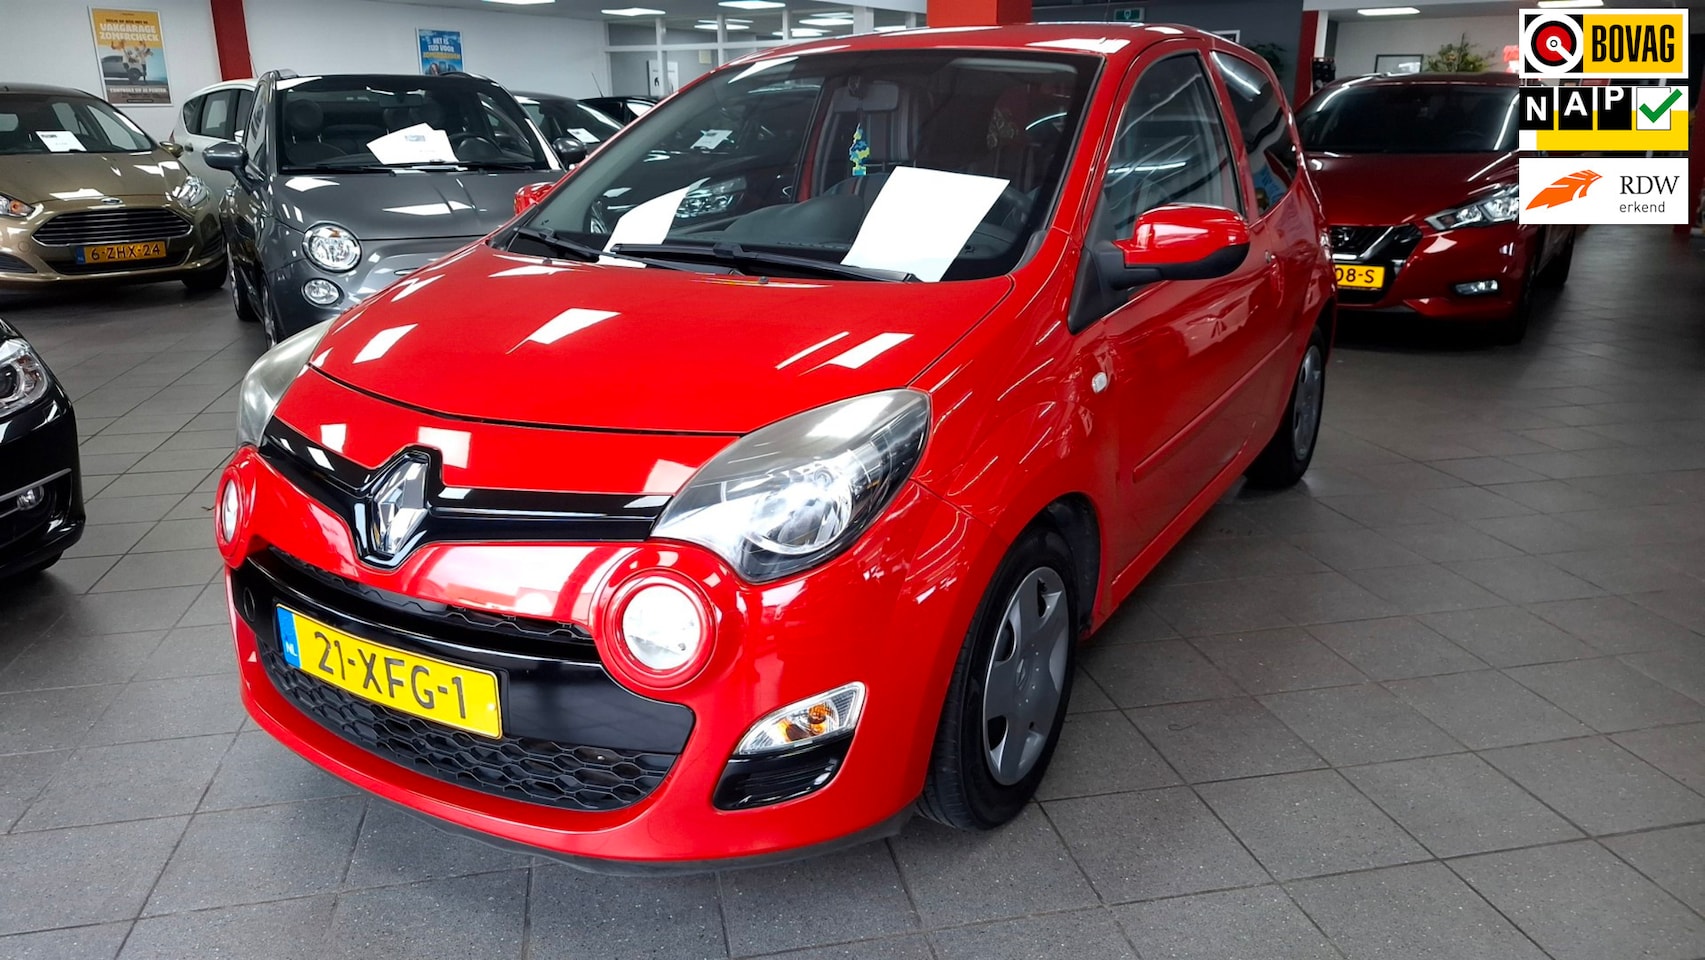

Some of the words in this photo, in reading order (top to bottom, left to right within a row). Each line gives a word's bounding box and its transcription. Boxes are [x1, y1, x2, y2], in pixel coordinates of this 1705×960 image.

[99, 23, 157, 34] VAKGARAGE
[99, 31, 160, 42] ZOMERCHECK
[91, 243, 161, 261] 6-ZHX-24
[286, 641, 298, 657] NL
[314, 631, 466, 720] 21-XFG-1
